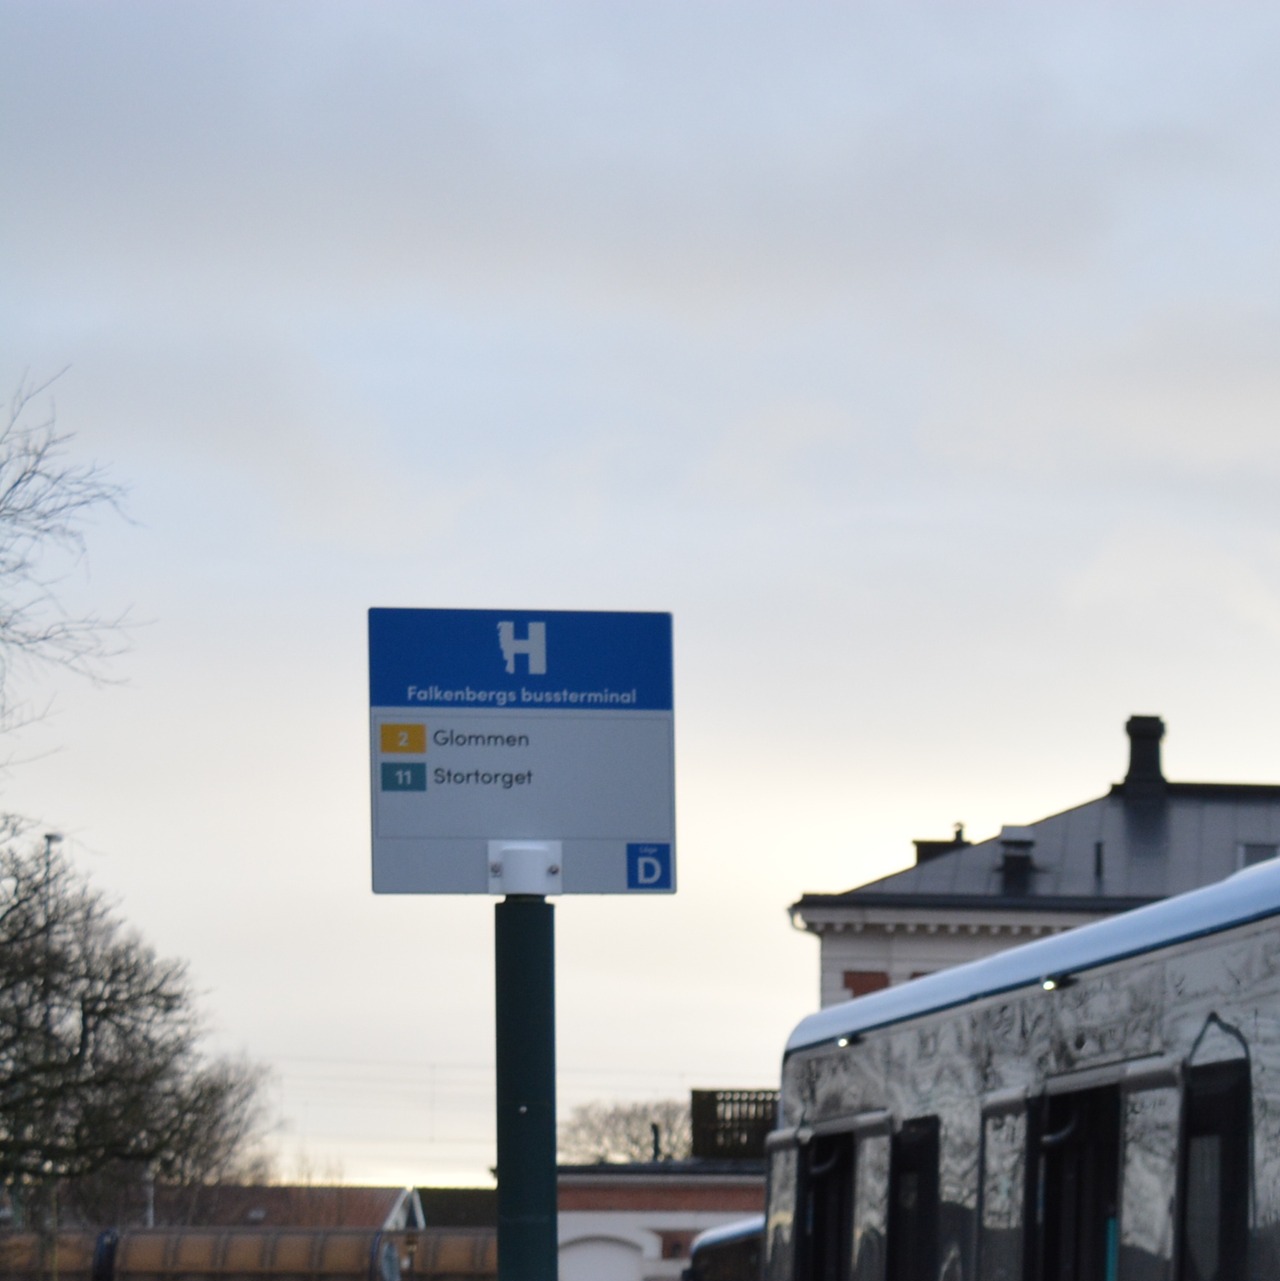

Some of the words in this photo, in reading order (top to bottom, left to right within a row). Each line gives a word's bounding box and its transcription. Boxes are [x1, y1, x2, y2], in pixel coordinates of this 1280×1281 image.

[407, 685, 517, 706] Falkenbergs
[521, 687, 637, 704] bussterminal
[398, 732, 409, 746] 2
[432, 729, 530, 748] Glommen
[395, 770, 412, 785] 11
[433, 767, 533, 789] Stortorget
[637, 857, 662, 884] D
